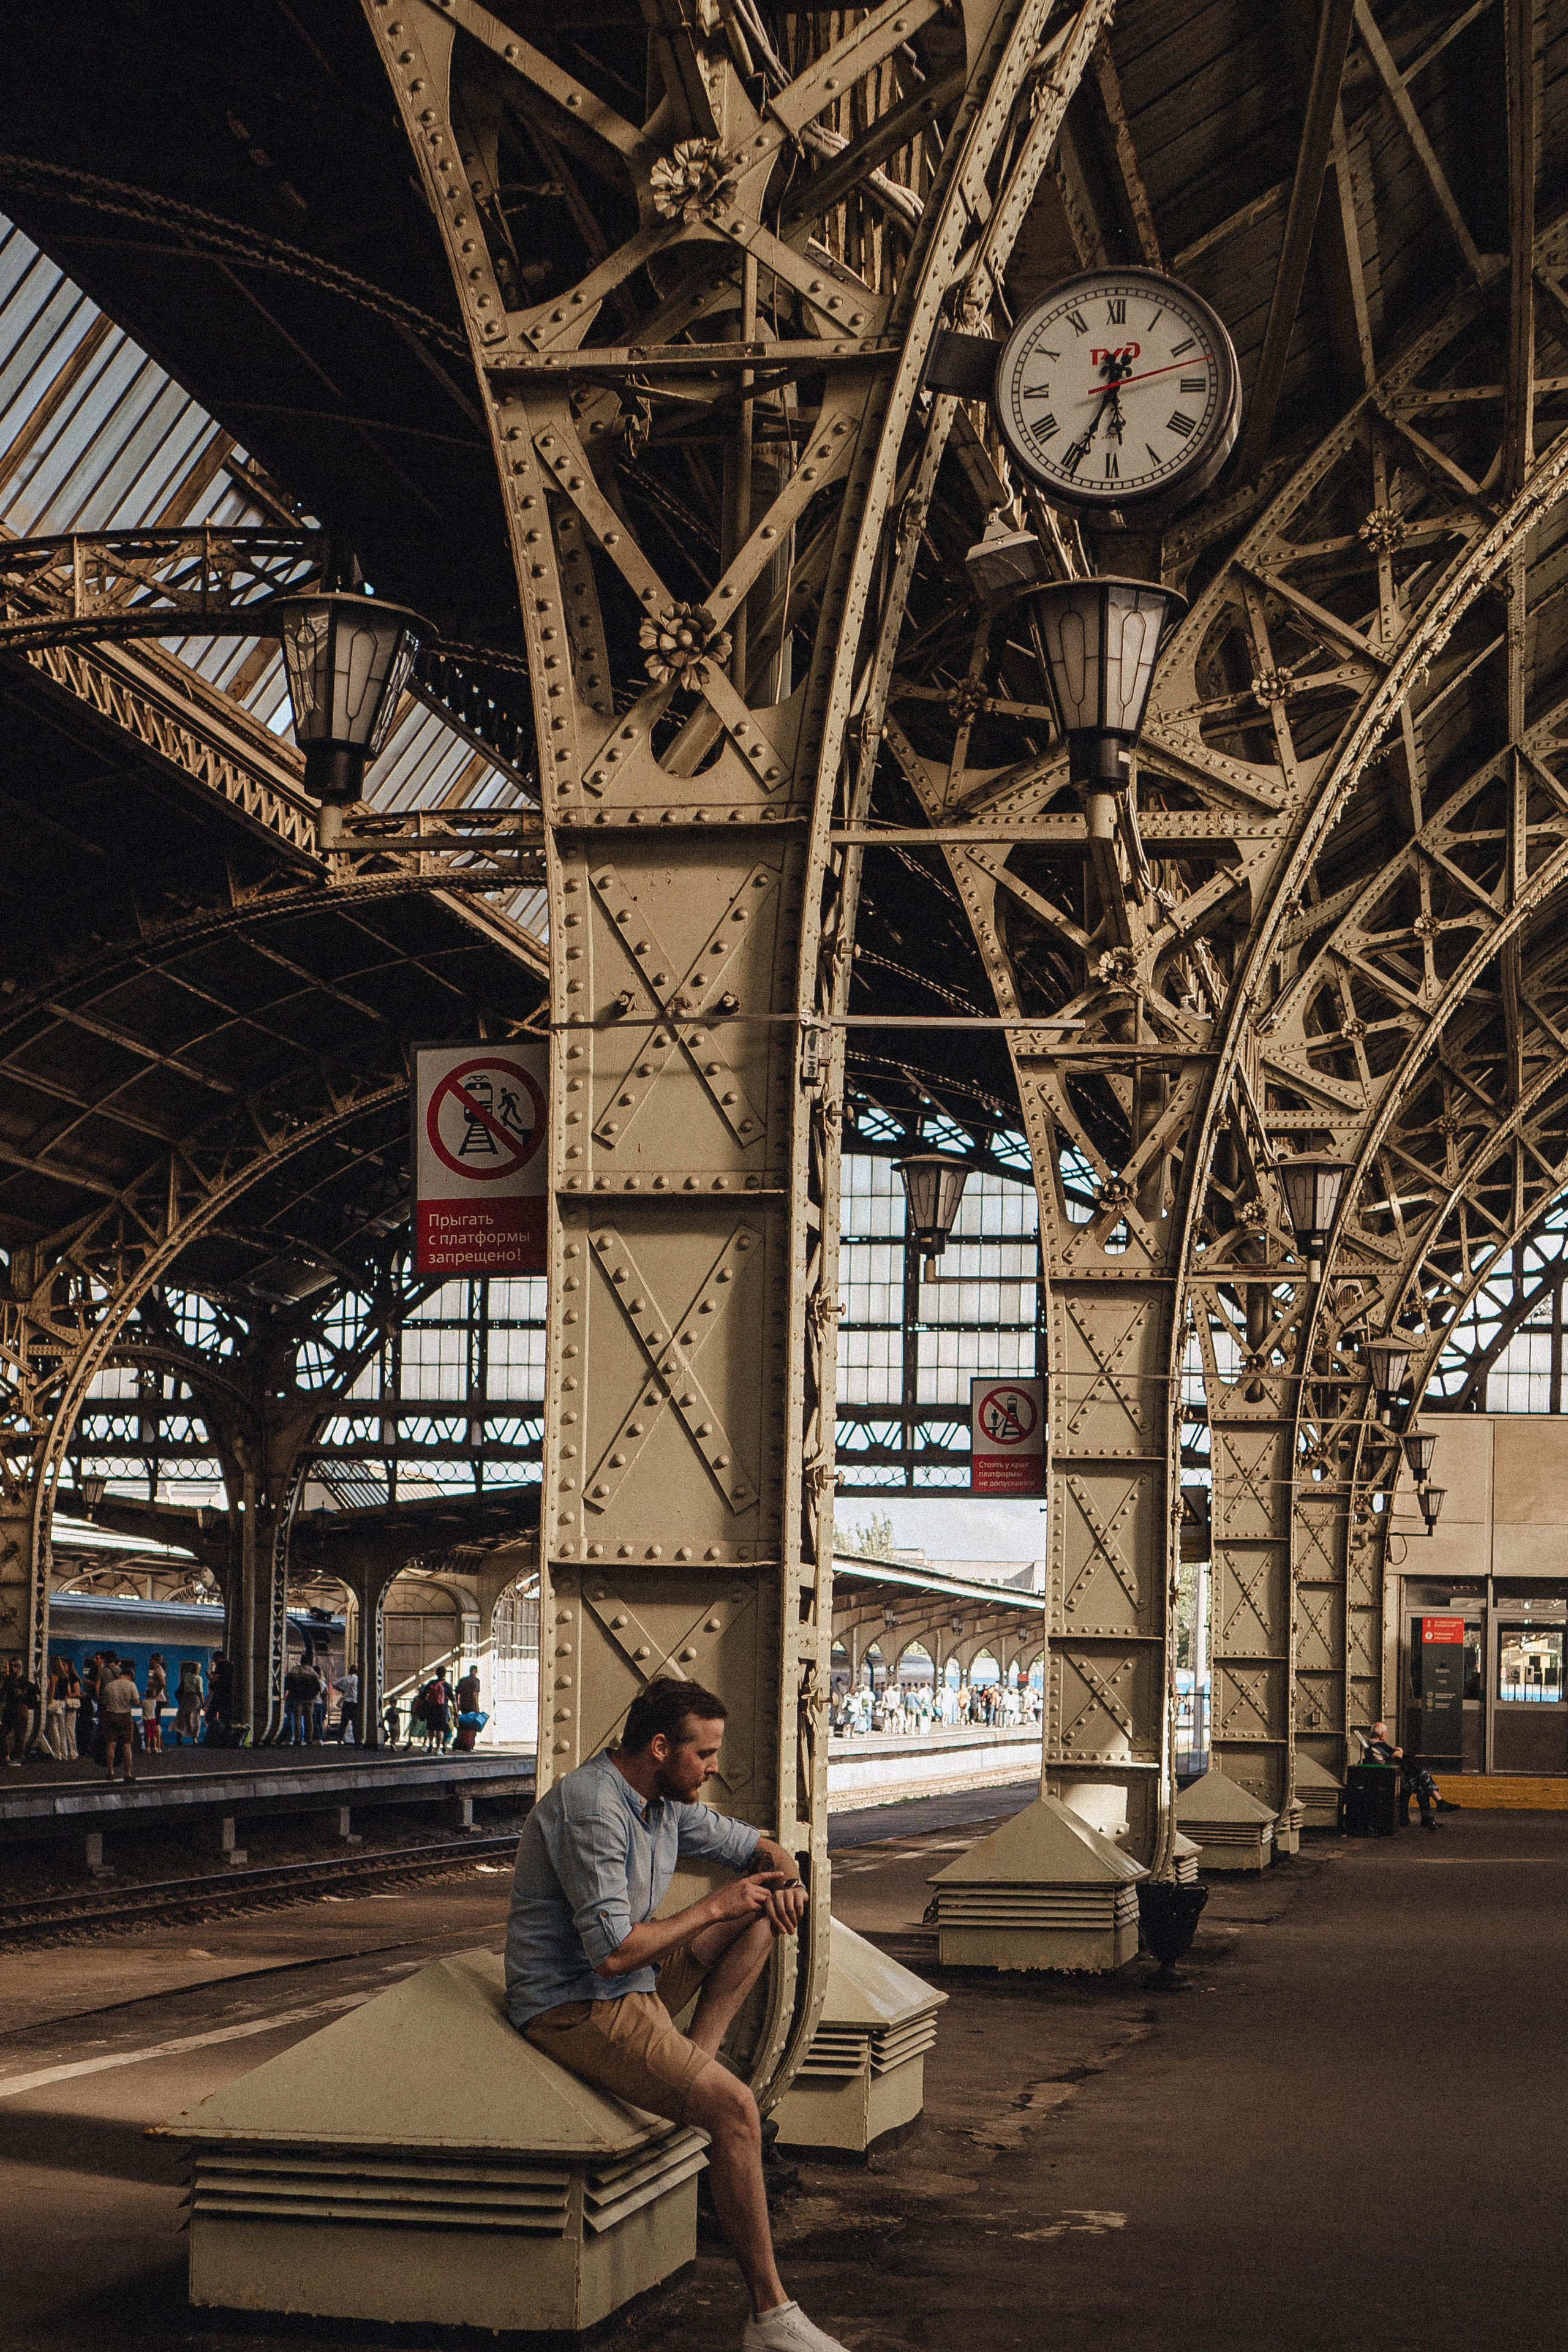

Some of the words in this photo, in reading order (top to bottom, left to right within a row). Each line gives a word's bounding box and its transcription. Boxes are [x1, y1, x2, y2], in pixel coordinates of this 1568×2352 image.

[1106, 299, 1126, 325] XII
[1065, 309, 1090, 337] XI
[1035, 344, 1061, 363] X
[1170, 338, 1196, 358] II
[1023, 383, 1049, 399] IX
[1180, 378, 1206, 393] III
[1105, 453, 1120, 478] VI
[429, 1213, 493, 1229] Прыгать
[429, 1235, 436, 1245] с
[440, 1231, 530, 1246] платформы
[428, 1248, 521, 1266] запрещено!
